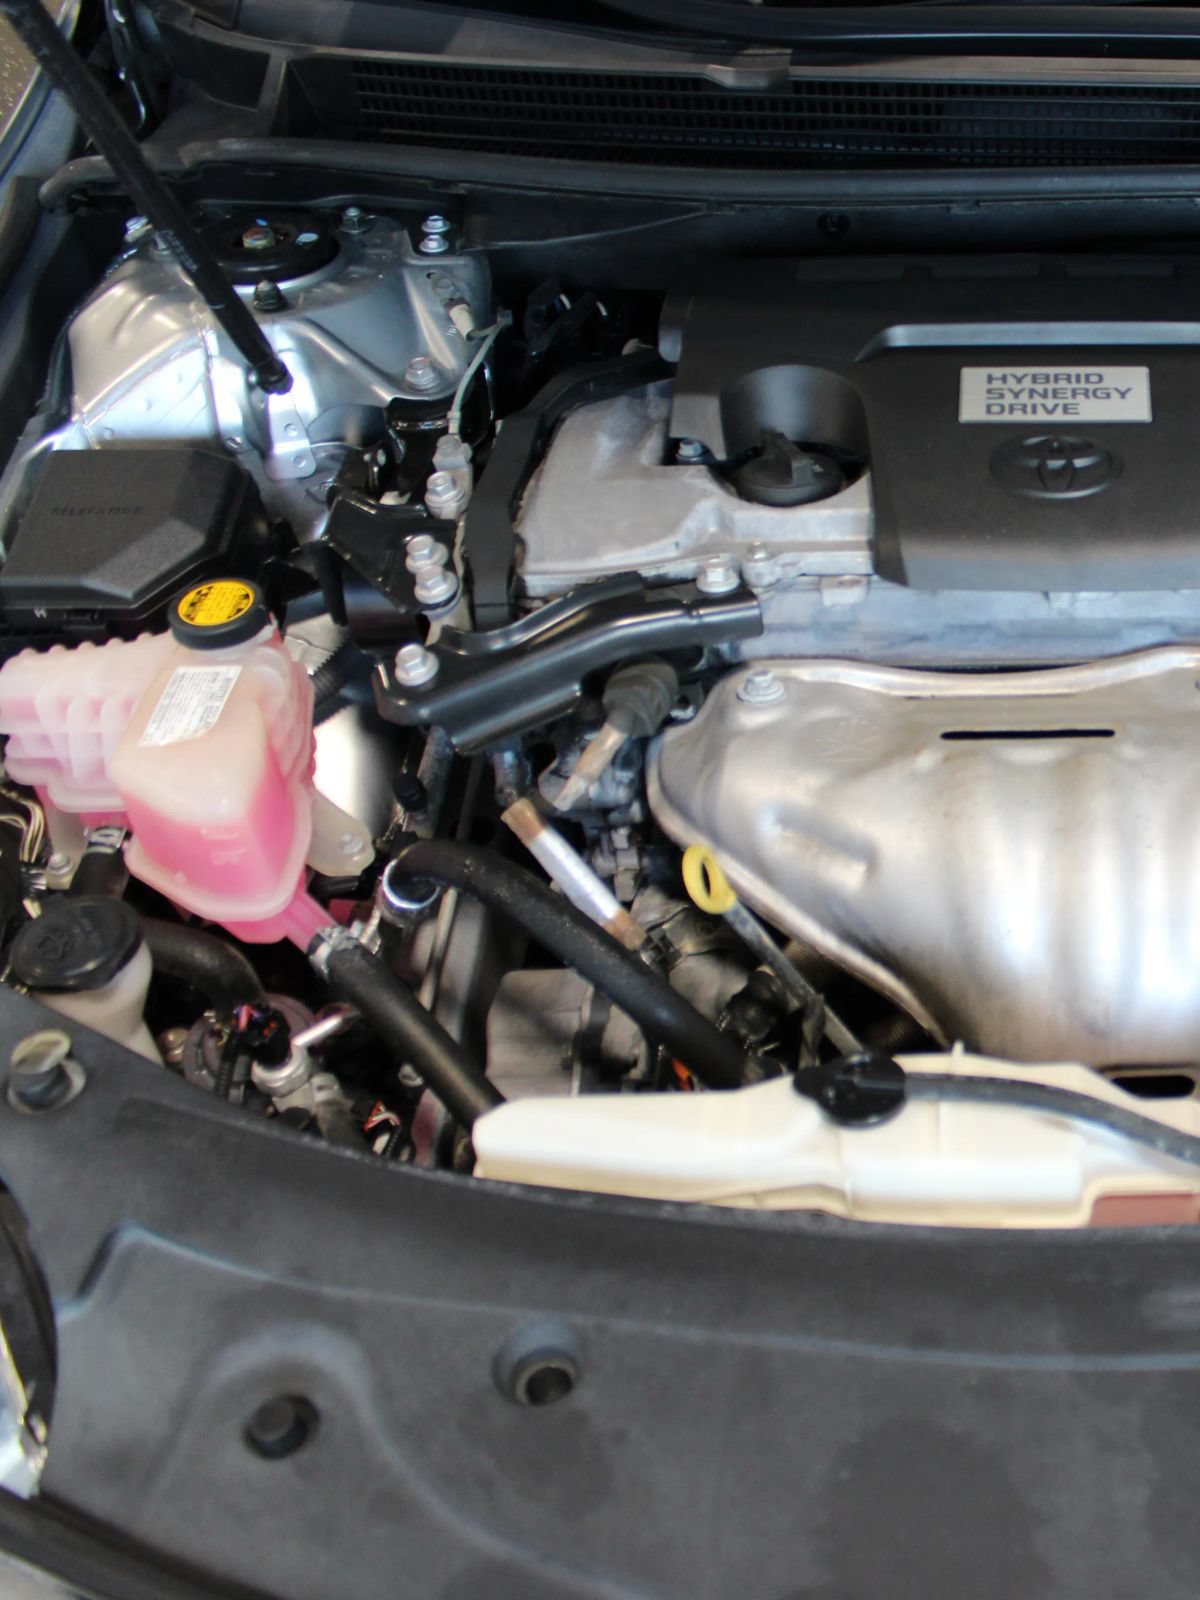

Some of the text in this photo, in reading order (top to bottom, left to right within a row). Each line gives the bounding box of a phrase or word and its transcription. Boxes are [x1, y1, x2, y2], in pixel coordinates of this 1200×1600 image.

[986, 373, 1104, 385] HYBRID
[985, 387, 1133, 400] SYNERGY
[985, 403, 1080, 415] DRIVE
